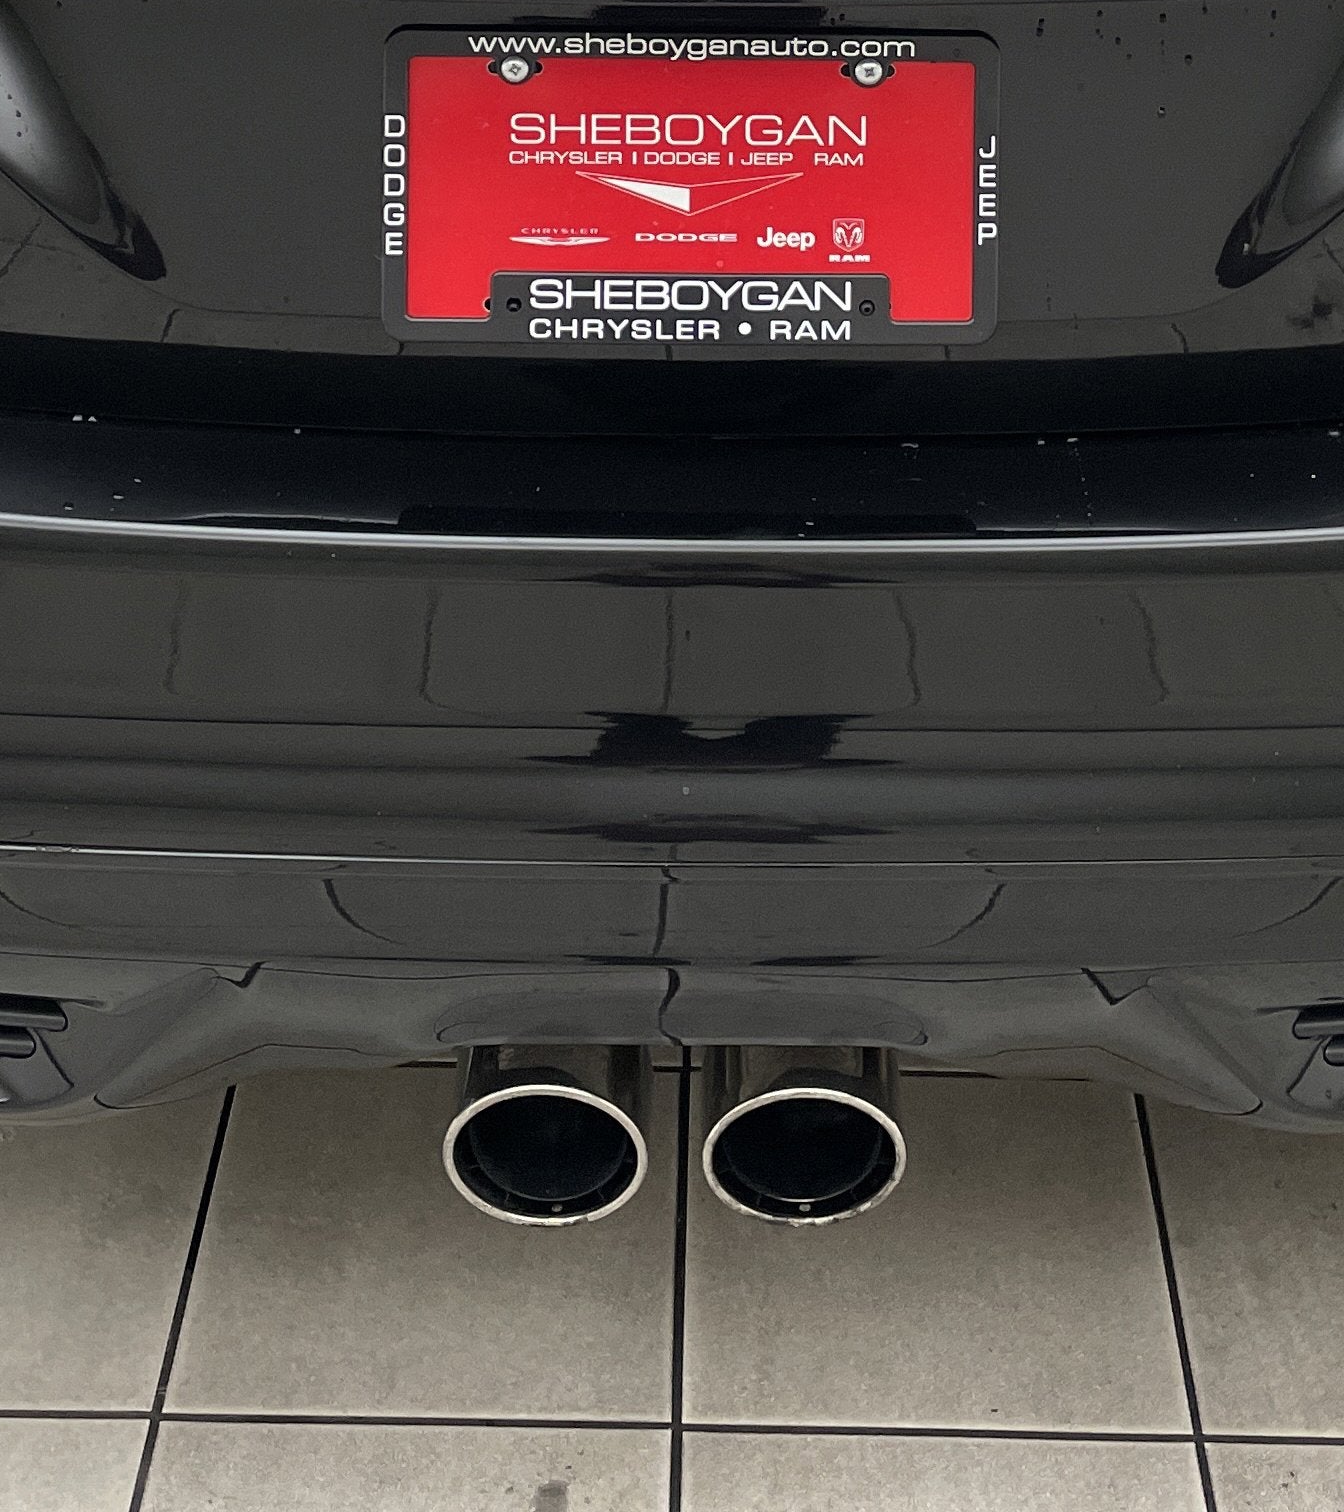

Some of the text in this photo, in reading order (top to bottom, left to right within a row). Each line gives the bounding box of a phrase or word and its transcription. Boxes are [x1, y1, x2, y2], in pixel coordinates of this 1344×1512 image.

[469, 33, 915, 60] www.sheboyganauto.com
[510, 114, 867, 146] SHEBOYGAN
[508, 151, 864, 167] CHRYSLER DODGE JEEP RAM
[383, 114, 406, 255] DODGE
[977, 136, 997, 247] JEEP
[636, 234, 737, 242] DODGE
[756, 226, 816, 251] Jeep
[529, 279, 851, 311] SHEBOYGAN
[529, 317, 851, 341] CHRYSLER RAM
